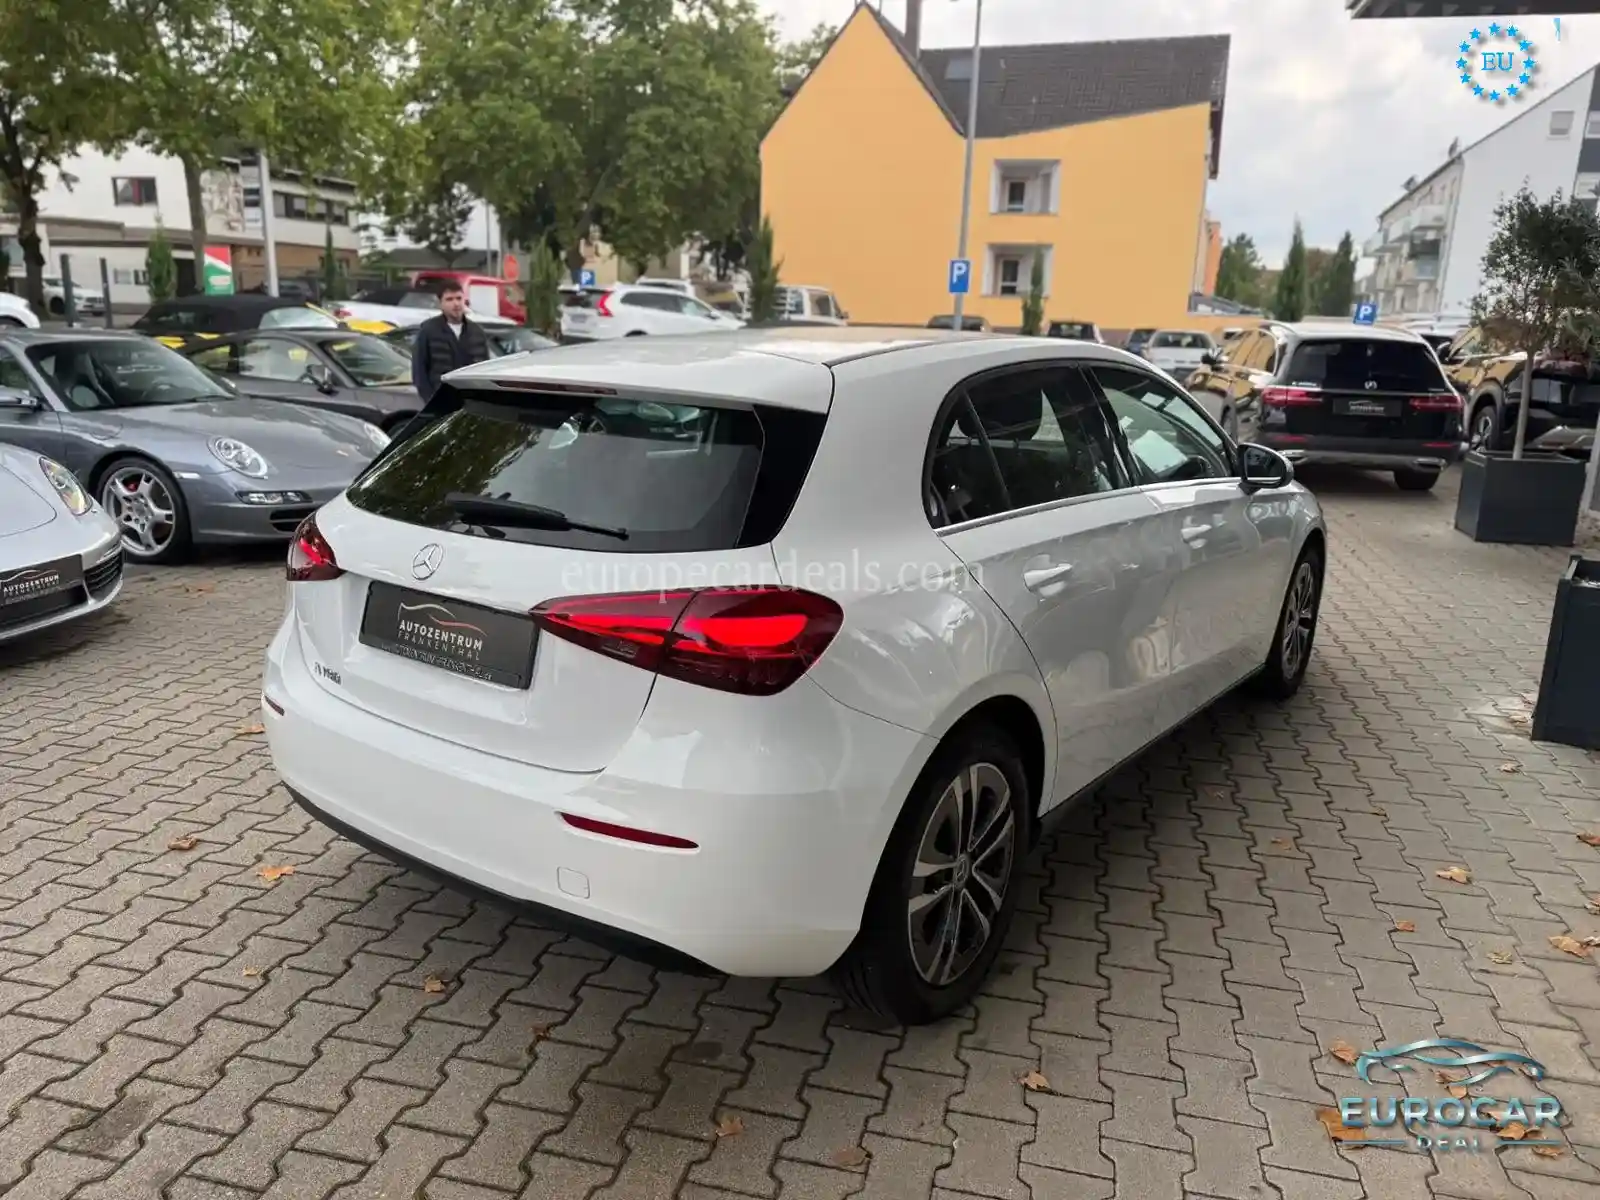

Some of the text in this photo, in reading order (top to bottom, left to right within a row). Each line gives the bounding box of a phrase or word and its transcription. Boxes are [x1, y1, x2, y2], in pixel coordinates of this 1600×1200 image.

[581, 271, 592, 285] P
[952, 261, 967, 284] P
[1359, 304, 1373, 321] P
[397, 630, 481, 661] FRANKENTHAL
[398, 619, 484, 652] AUTOZENTRUM
